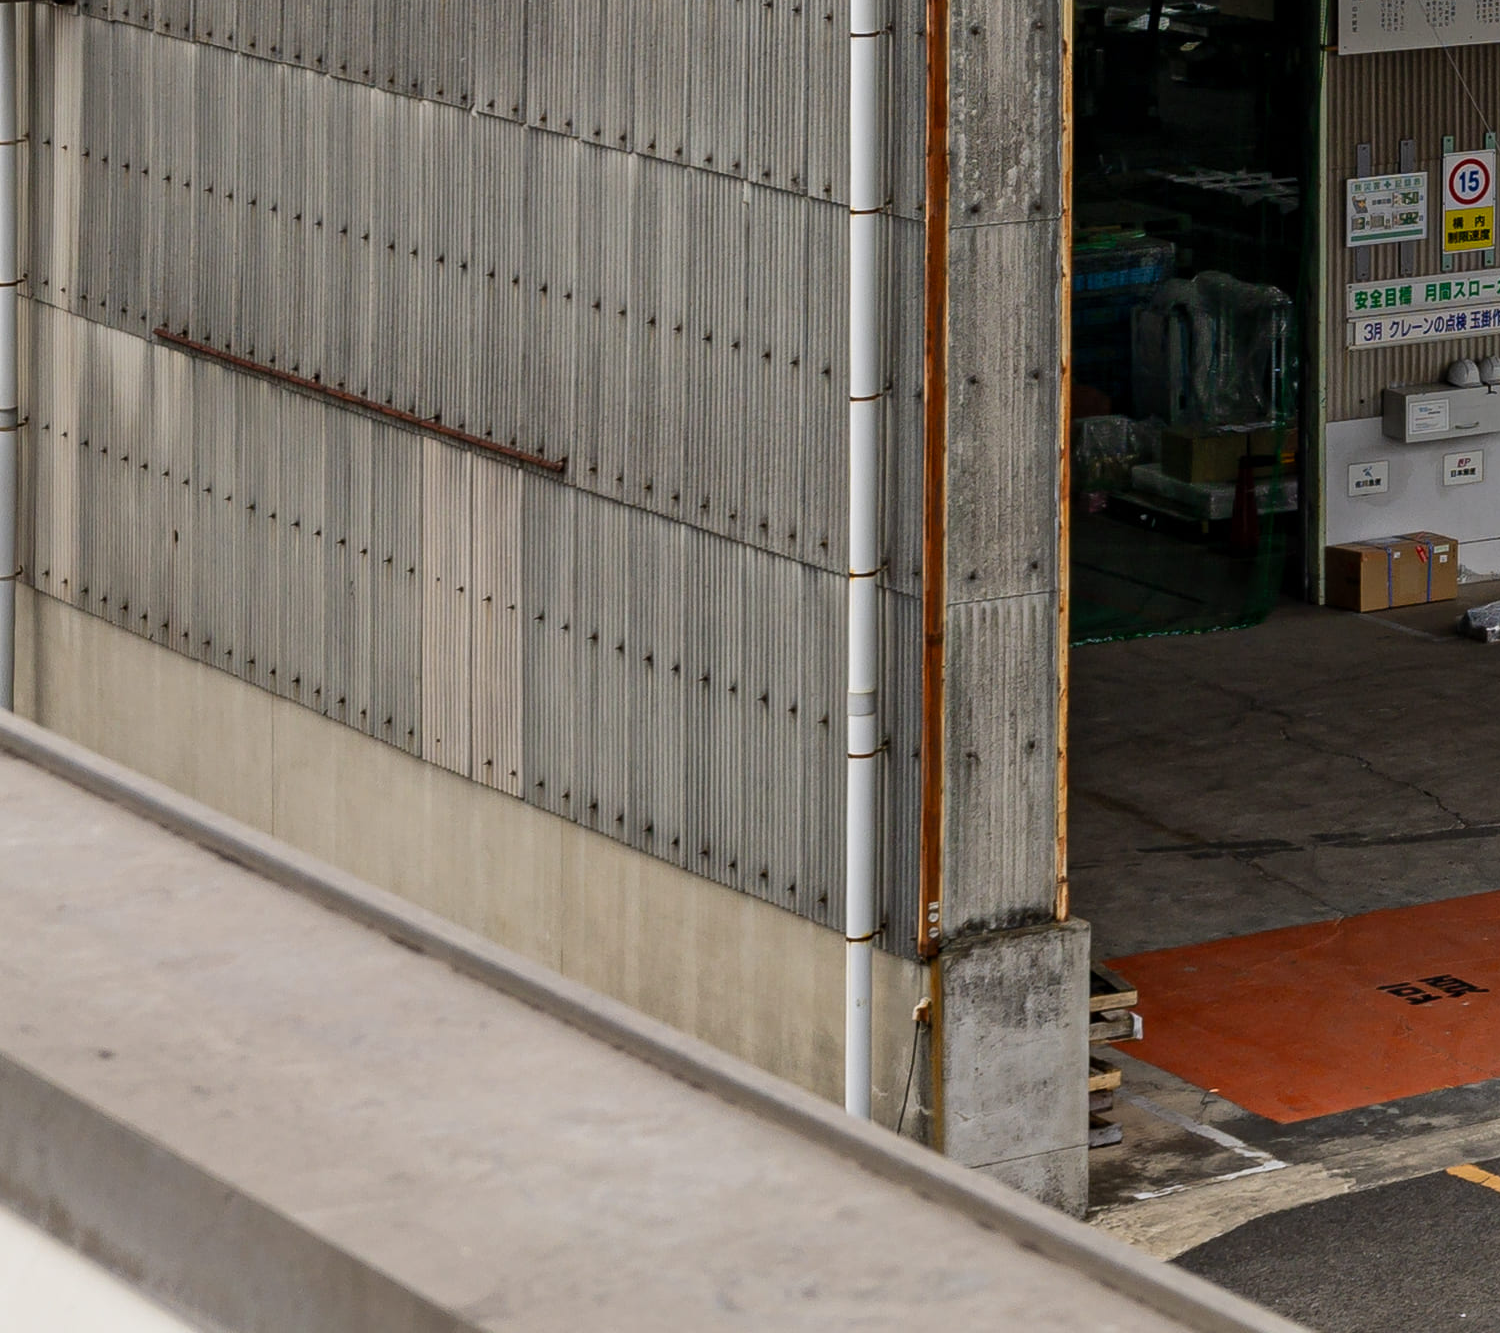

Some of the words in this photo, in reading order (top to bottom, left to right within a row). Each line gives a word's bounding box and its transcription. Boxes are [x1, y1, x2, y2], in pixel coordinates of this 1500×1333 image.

[1459, 170, 1479, 193] 15
[1447, 229, 1490, 244] 制限速度
[1354, 285, 1413, 310] 安全目標
